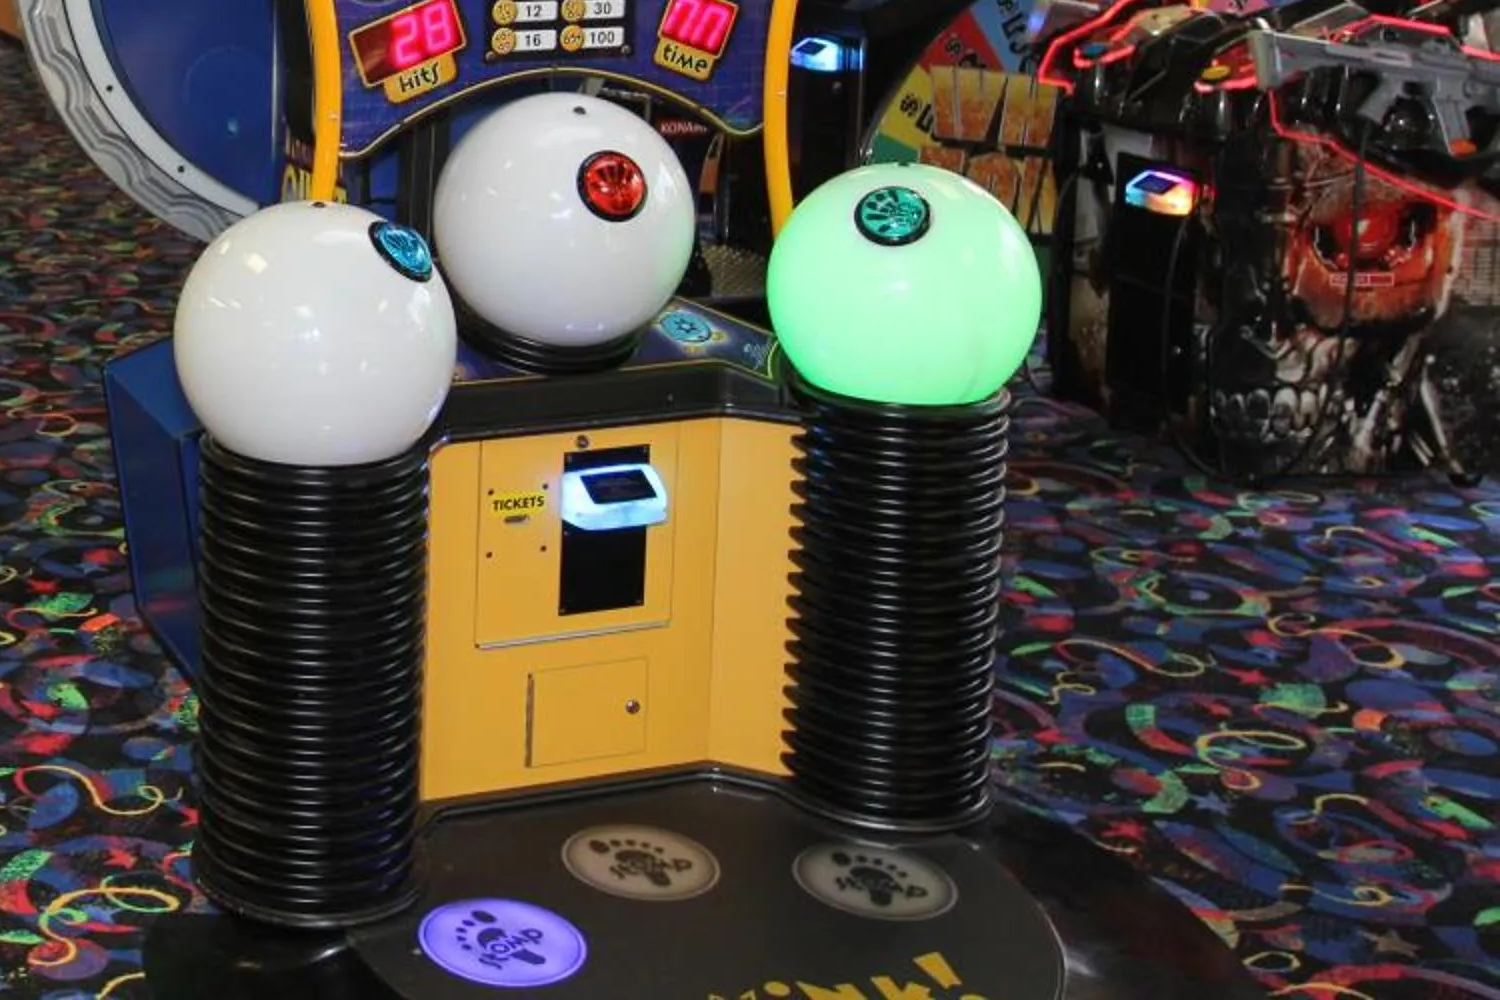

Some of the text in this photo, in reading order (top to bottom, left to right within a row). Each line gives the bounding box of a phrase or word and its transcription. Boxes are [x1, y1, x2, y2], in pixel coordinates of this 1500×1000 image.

[525, 4, 543, 18] 12
[593, 1, 613, 15] 30
[391, 2, 455, 69] 28
[525, 33, 542, 47] 16
[589, 31, 616, 45] 100
[492, 496, 545, 512] TICKETS
